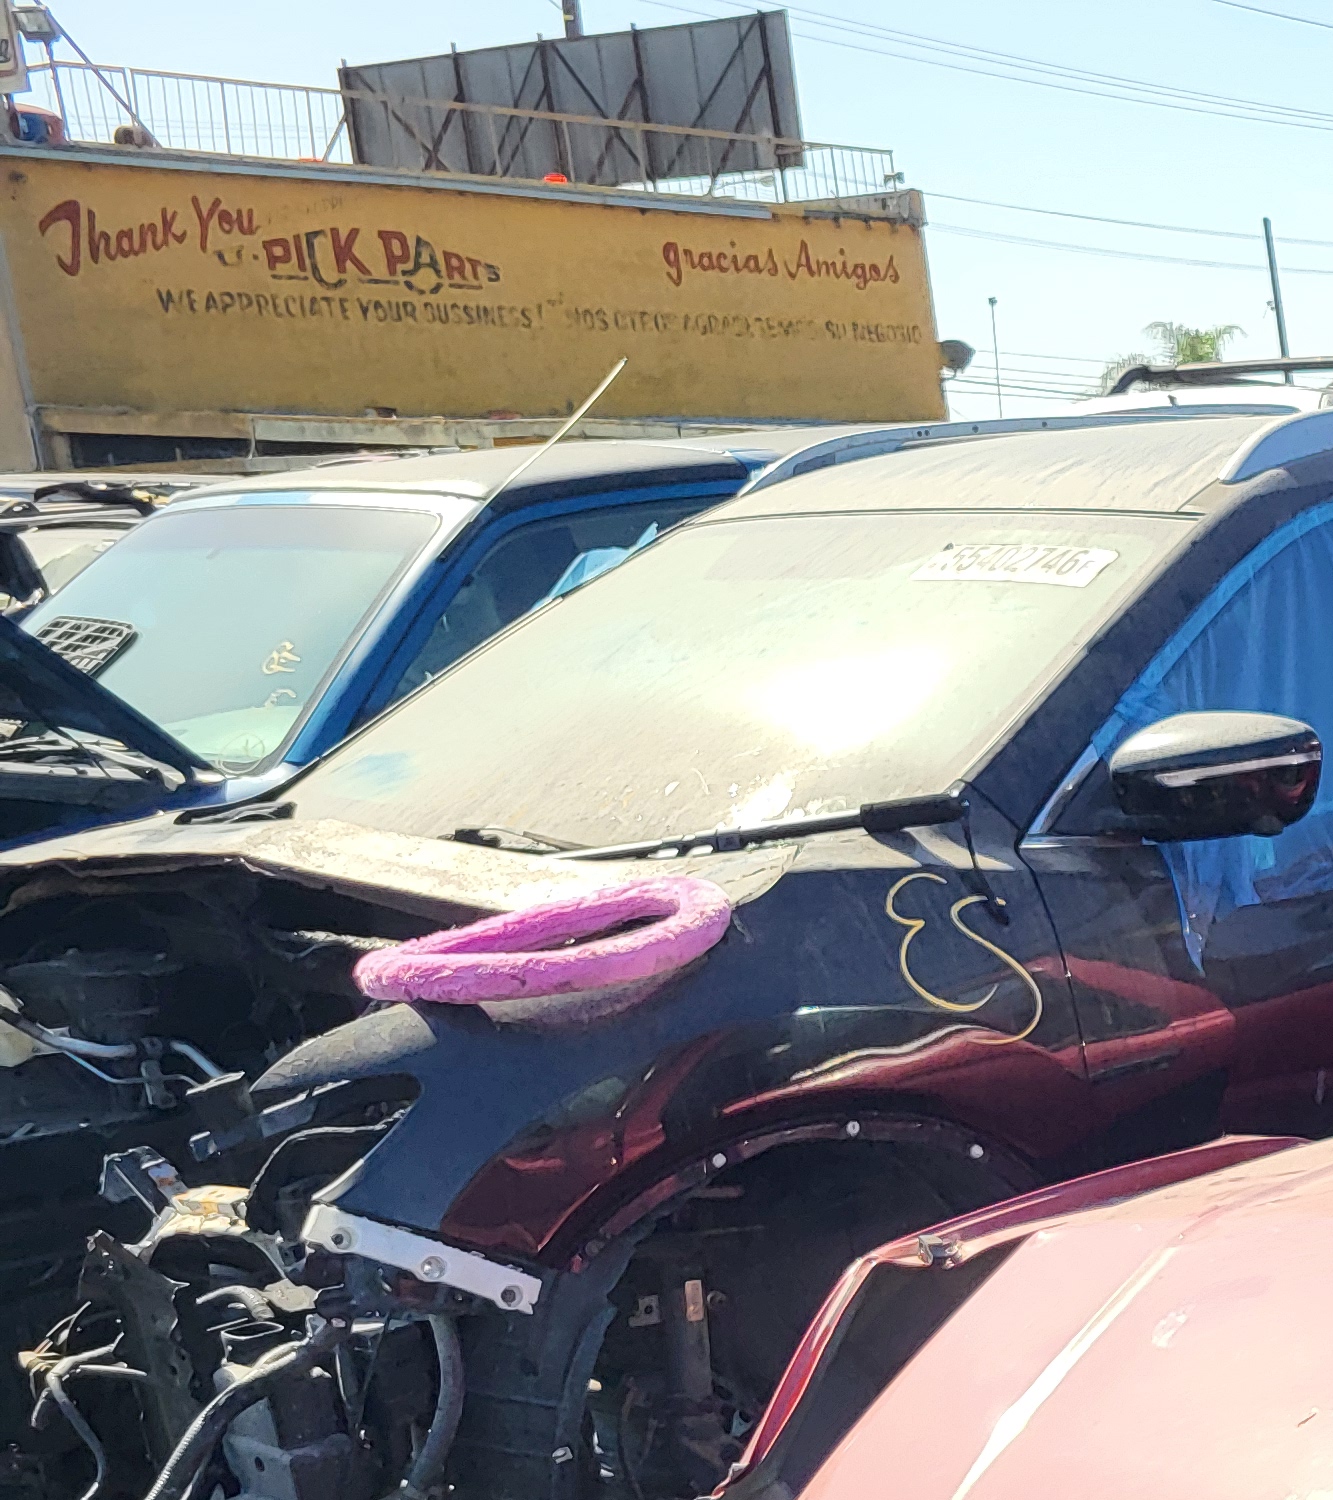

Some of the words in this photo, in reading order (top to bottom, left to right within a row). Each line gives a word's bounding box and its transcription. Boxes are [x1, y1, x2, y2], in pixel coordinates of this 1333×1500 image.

[38, 199, 187, 277] Thank
[191, 195, 261, 253] You
[783, 239, 900, 290] Amigos
[156, 287, 197, 314] WE
[204, 290, 350, 321] APPRECIATE
[355, 296, 418, 324] YOUR
